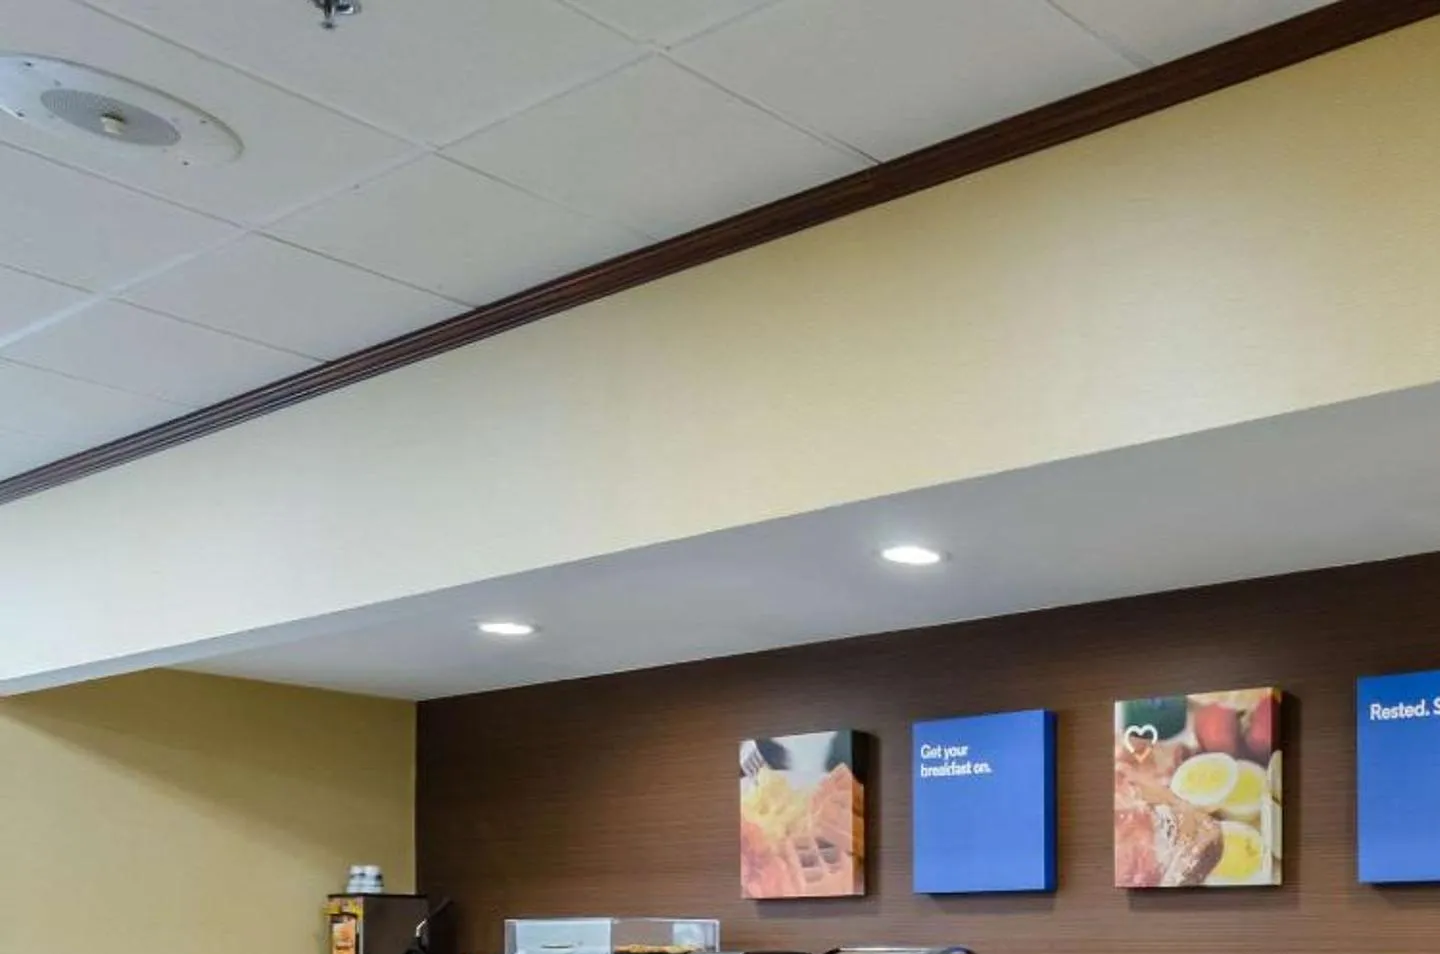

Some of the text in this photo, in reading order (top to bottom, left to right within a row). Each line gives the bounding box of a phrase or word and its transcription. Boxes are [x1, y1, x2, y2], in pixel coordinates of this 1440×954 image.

[1369, 698, 1430, 720] Rested.
[920, 744, 969, 760] Get your
[920, 761, 993, 777] breakfast on.
